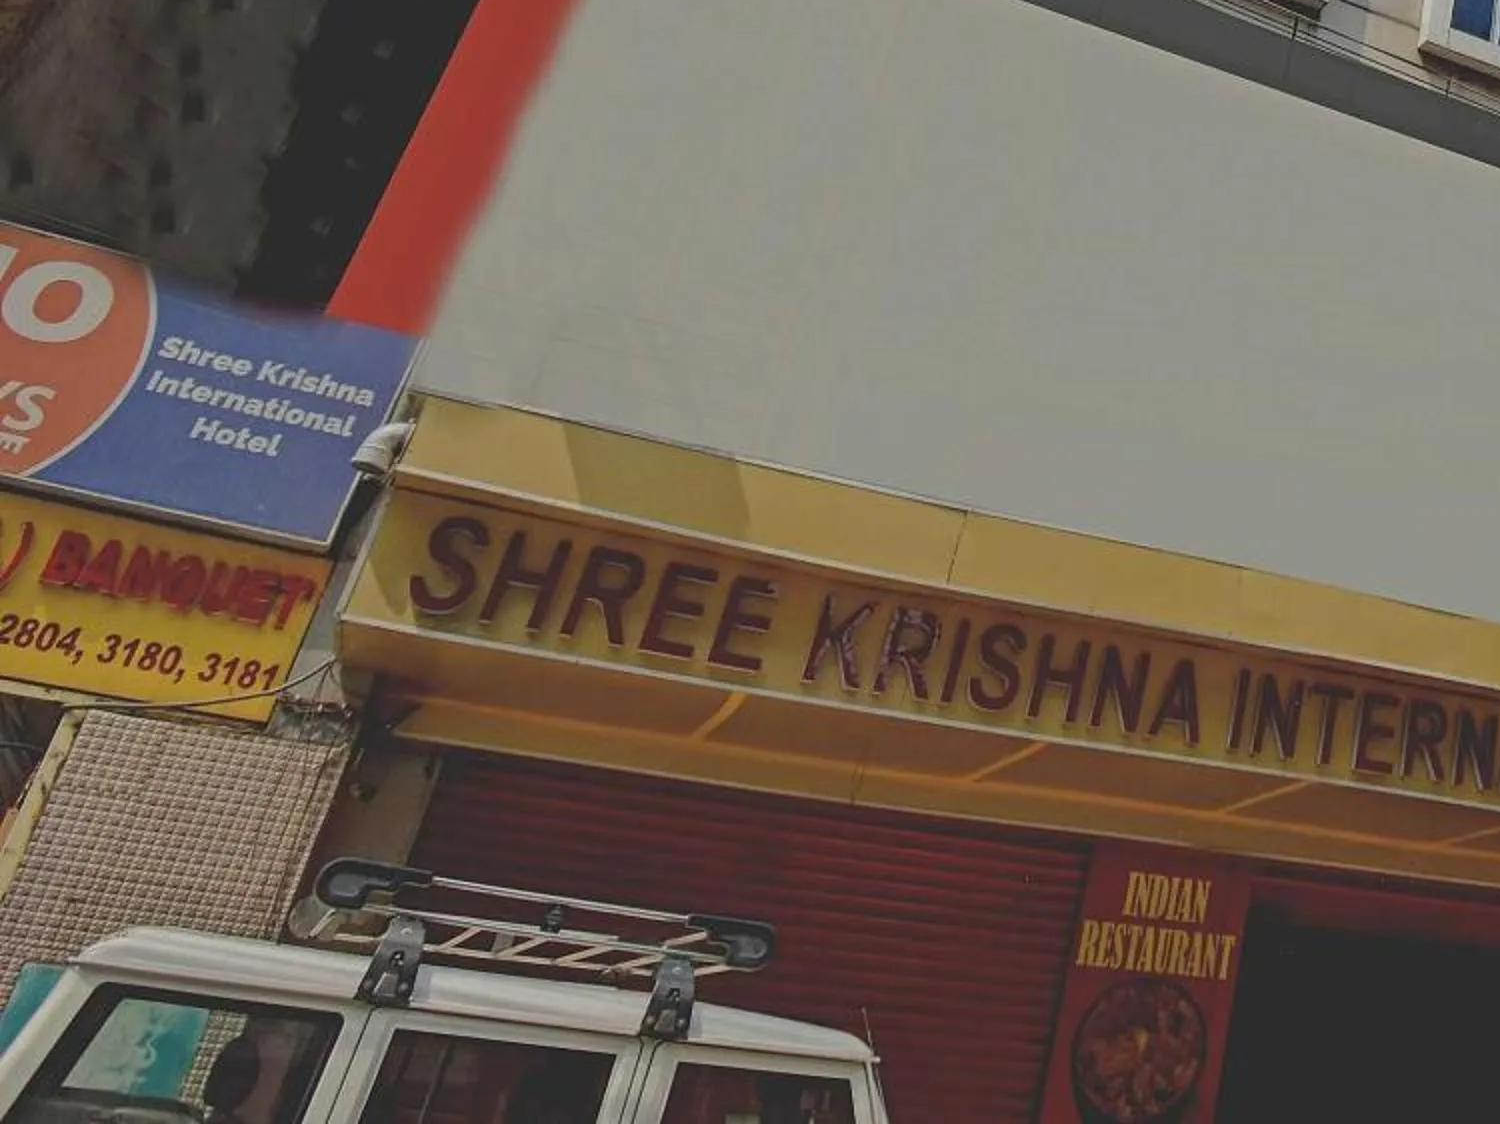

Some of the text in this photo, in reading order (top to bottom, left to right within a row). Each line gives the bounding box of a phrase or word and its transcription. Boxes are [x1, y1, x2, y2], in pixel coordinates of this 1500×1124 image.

[0, 243, 115, 343] O
[146, 369, 357, 438] International
[157, 335, 376, 408] Shree Krishna
[190, 416, 283, 457] Hotel
[40, 529, 318, 631] BANQUET
[96, 633, 187, 685] 3180,
[198, 652, 281, 691] 3181
[408, 516, 779, 673] SHREE
[800, 592, 1201, 748] KRISHNA
[1122, 870, 1212, 925] INDIAN
[1075, 918, 1237, 981] RESTAURANT
